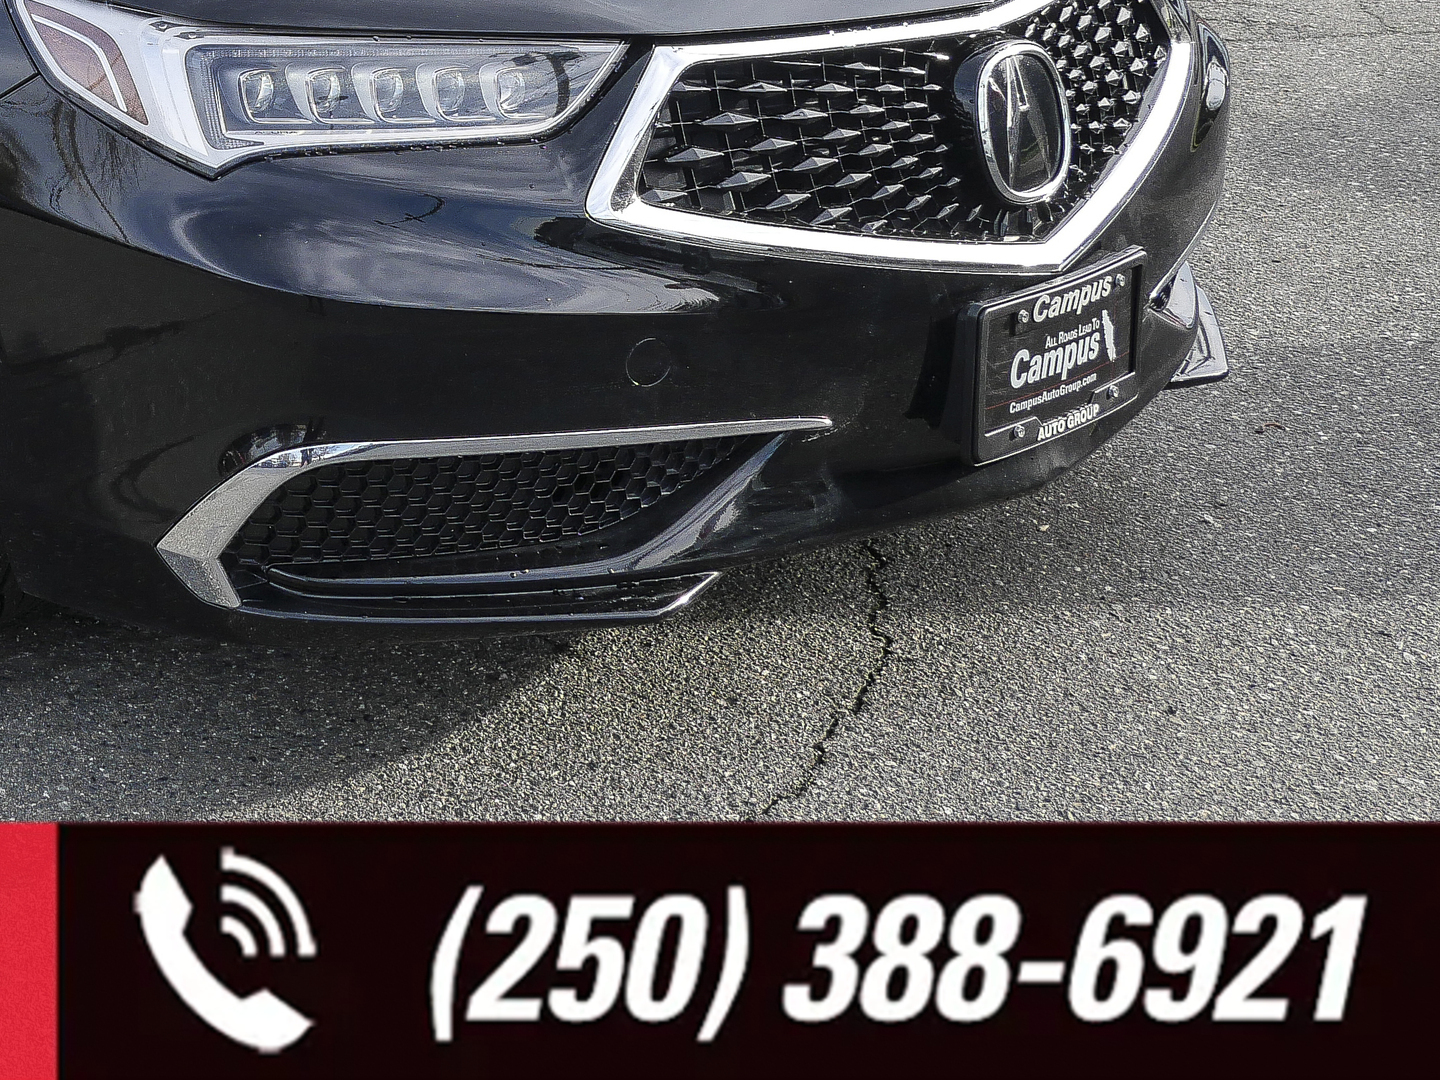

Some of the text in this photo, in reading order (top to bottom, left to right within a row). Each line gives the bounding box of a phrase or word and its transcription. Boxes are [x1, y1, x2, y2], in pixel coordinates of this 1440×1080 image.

[1032, 275, 1113, 323] Campus
[1009, 331, 1101, 389] Campus
[1009, 372, 1098, 414] CampusAutoGroup.com
[1037, 403, 1100, 441] AUTO GROUP
